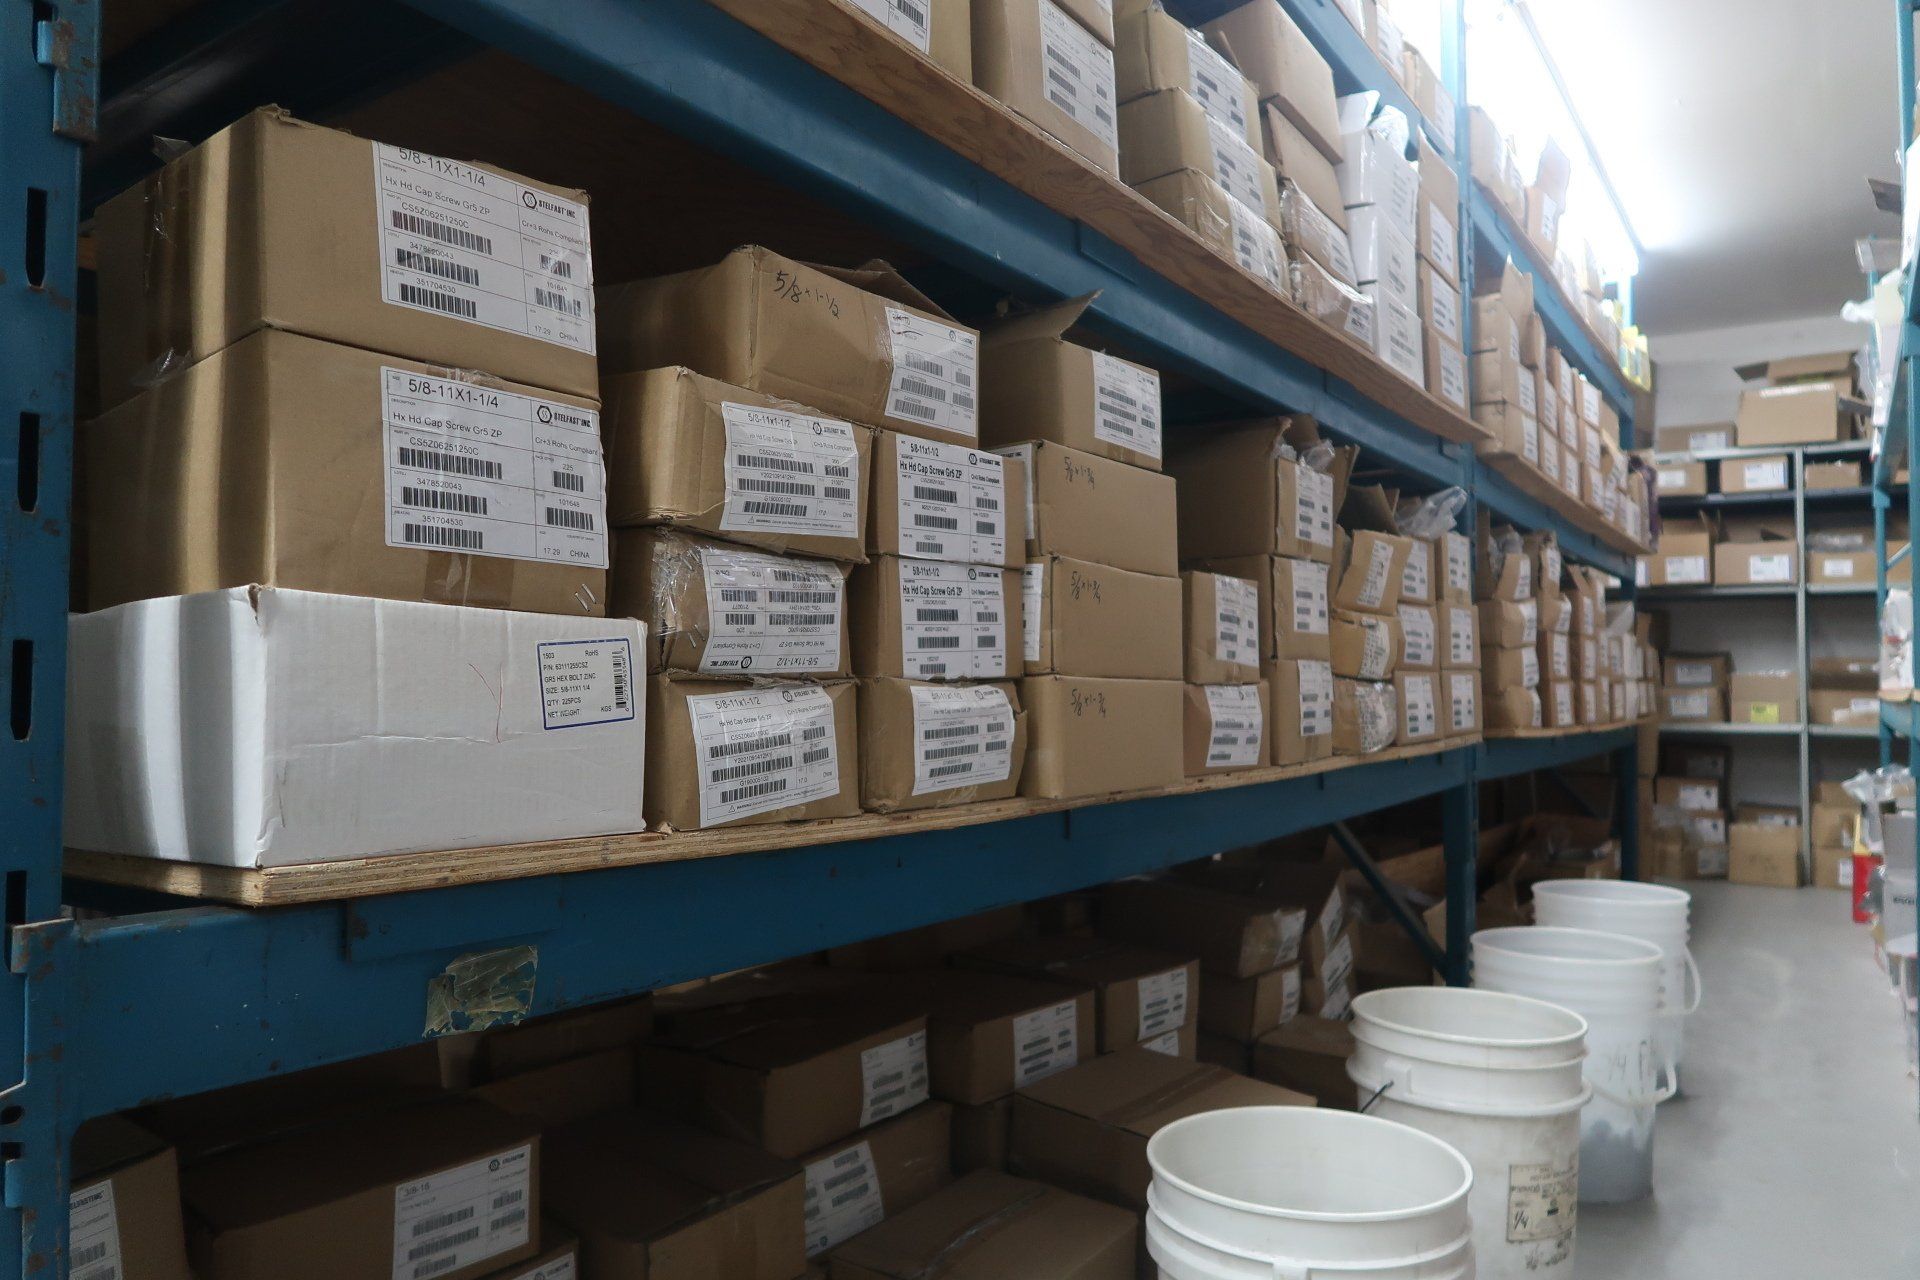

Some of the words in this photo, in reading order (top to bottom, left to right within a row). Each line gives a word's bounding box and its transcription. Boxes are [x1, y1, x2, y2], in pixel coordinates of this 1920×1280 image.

[399, 148, 486, 187] 5/8-11X1-1/4
[385, 175, 398, 186] Hx
[400, 180, 413, 191] Hd
[415, 185, 432, 197] Cap
[435, 191, 461, 206] Screw
[462, 200, 477, 212] Gr5
[480, 206, 490, 215] ZP
[773, 270, 803, 303] 5/8
[409, 379, 499, 408] 5/8-11X1-1/4
[393, 412, 406, 421] Hx
[408, 414, 422, 424] Hd
[424, 417, 443, 429] Cap
[445, 420, 471, 433] Screw
[473, 426, 489, 436] Gr5
[490, 429, 502, 438] ZP
[409, 436, 479, 456] CS5Z06251250C
[900, 460, 907, 470] Hx
[908, 461, 917, 469] Hd
[917, 462, 929, 475] Cap
[929, 465, 945, 476] Screw
[416, 478, 462, 491] 3478520043
[422, 515, 463, 526] 351704530
[570, 549, 590, 559] CHINA
[919, 586, 929, 597] Cap
[930, 587, 946, 596] Screw
[584, 649, 599, 657] RoHS
[569, 673, 583, 681] BOLT
[584, 672, 596, 680] ZINC
[1071, 688, 1082, 717] 5/8
